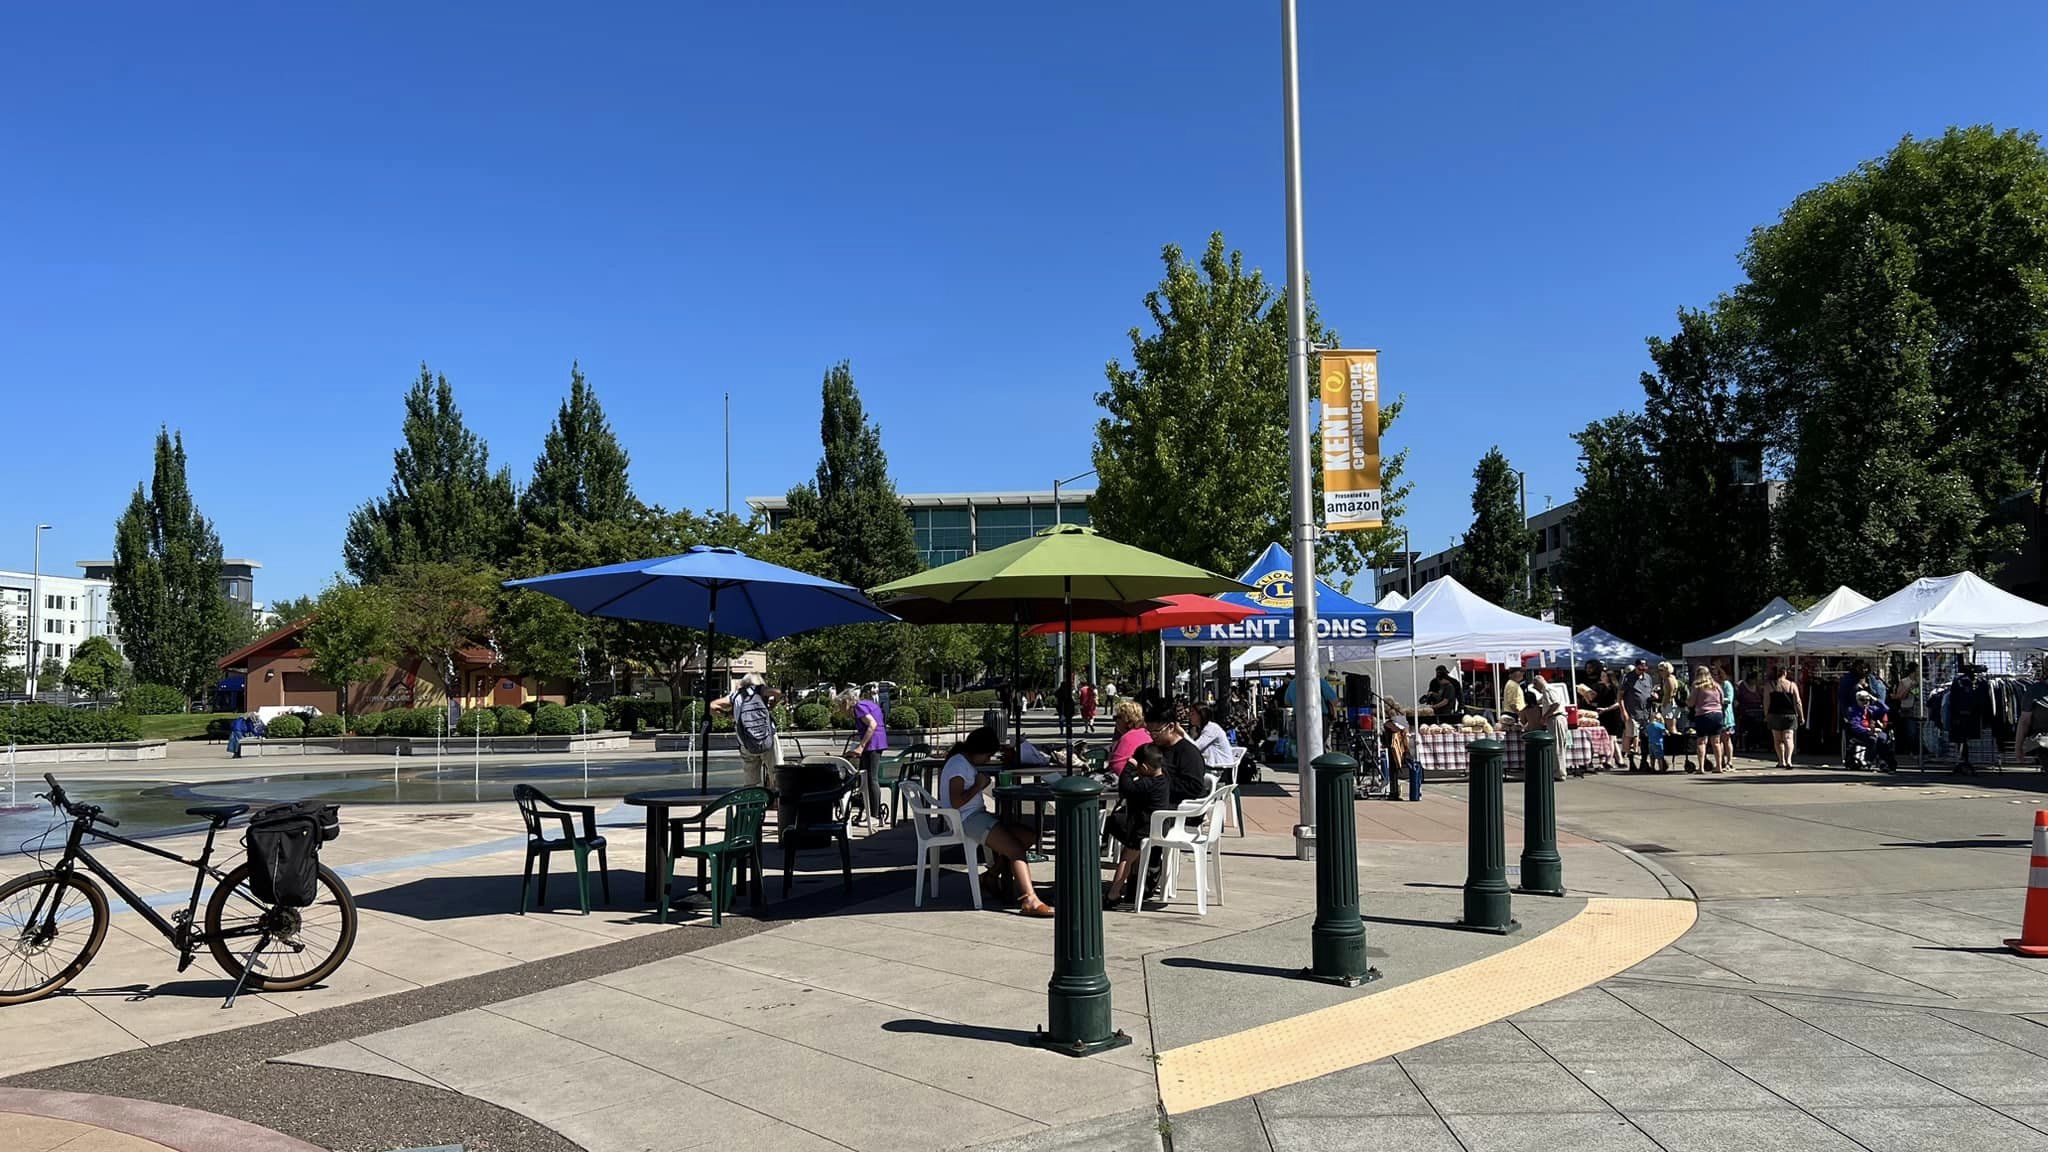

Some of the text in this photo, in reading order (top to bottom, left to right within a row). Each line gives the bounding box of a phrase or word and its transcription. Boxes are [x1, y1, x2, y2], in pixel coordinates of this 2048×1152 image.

[1363, 362, 1376, 402] DAYS
[1350, 362, 1365, 470] CORNUCOPIA
[1323, 404, 1350, 470] KENT
[1327, 500, 1379, 513] amazon
[1261, 572, 1294, 584] LION
[1274, 583, 1293, 596] L
[1210, 618, 1367, 639] KENT LONS
